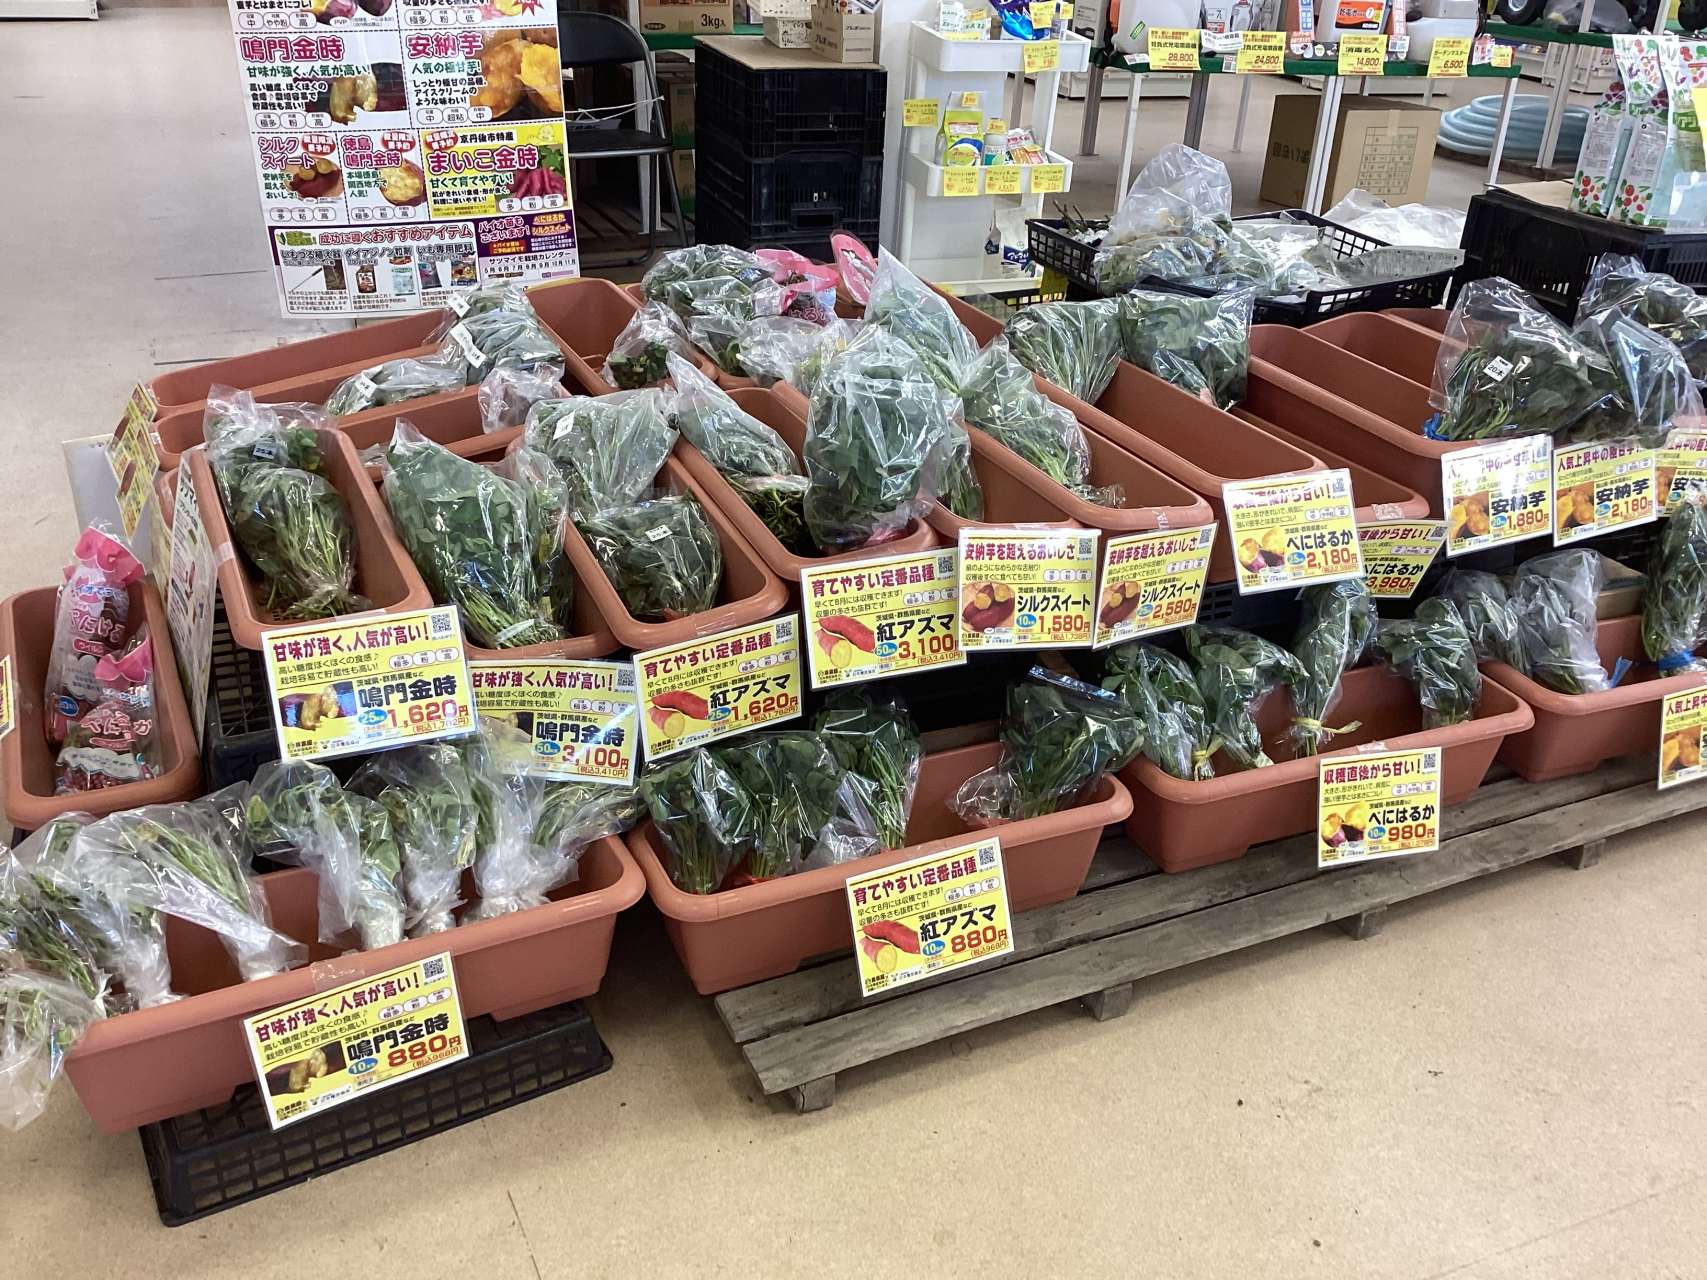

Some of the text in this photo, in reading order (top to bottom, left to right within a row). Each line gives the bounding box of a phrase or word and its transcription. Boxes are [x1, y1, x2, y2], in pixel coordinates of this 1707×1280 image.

[241, 36, 344, 62] 鳴門金時
[407, 31, 483, 59] 安納芋
[246, 64, 371, 79] 甘味が強く、人気が高い!
[411, 61, 482, 75] 人気の極甘芋!
[414, 86, 477, 97] アイスクリームの
[415, 96, 467, 107] ような味わい!
[258, 136, 299, 153] シルク
[341, 135, 373, 152] 徳島
[459, 131, 514, 144] 京丹後市特産
[262, 153, 316, 170] スイート
[343, 150, 403, 168] 鳴門金時
[427, 146, 539, 175] まいこ金時
[347, 179, 388, 189] 関西地方で
[430, 173, 513, 188] 甘くて育てやすい!
[265, 191, 298, 200] おいしさ!
[350, 190, 368, 198] 人気!
[319, 224, 474, 246] 成功に導くおすすめアイテム
[480, 224, 531, 244] ございます!
[416, 243, 475, 256] いも専用肥料
[489, 251, 572, 266] サツマイモ栽培カレンダー
[565, 258, 576, 266] 11月
[1596, 477, 1650, 506] 安納芋
[1491, 490, 1547, 516] 安納芋
[1611, 496, 1654, 518] 2,180円
[1506, 508, 1550, 530] 1,880円
[1286, 529, 1354, 551] べにはるか
[965, 543, 1076, 561] 安納芋を超えるおいしさ
[1108, 537, 1198, 567] 安納芋を超えるおいしさ
[1306, 547, 1358, 569] 2,180円
[811, 563, 935, 599] 育てやすい定番品種
[1140, 579, 1201, 605] シルクスイート
[1366, 576, 1416, 590] 3,980円
[1016, 593, 1091, 613] シルクスイート
[1152, 598, 1198, 621] 2,580円
[876, 613, 956, 643] 紅アズマ
[1038, 614, 1091, 635] 1,580円
[273, 621, 430, 663] 甘味が強く、人気が高い！
[643, 631, 774, 679] 育てやすい定番品種
[917, 652, 963, 665] (税込3,410円)
[280, 663, 379, 685] 栽培容易で貯蔵性も高い!
[356, 671, 424, 686] 茨城県・群馬県産など
[472, 670, 614, 692] 甘味が強く、人気が高い！
[357, 674, 457, 709] 鳴門金時
[709, 673, 791, 709] 紅アズマ
[387, 699, 470, 729] 1,620円
[731, 692, 799, 721] 1,620円
[535, 721, 625, 747] 鳴門金時
[562, 744, 630, 770] 3,100円
[576, 765, 629, 777] (税込3,410円)
[1323, 758, 1422, 785] 収穫直後から甘い！
[1368, 804, 1435, 826] べにはるか
[1388, 823, 1436, 842] 980円
[852, 856, 978, 907] 育てやすい定番品種
[857, 887, 945, 917] 早くて8月には収穫できます!
[858, 900, 930, 927] 収量の多さも抜群です!
[919, 904, 997, 943] 紅アズマ
[950, 925, 1008, 954] 880円
[970, 940, 1010, 958] (税込968円)
[255, 971, 421, 1044] 甘味が強く、人気が高い！
[346, 1012, 450, 1062] 鳴門金時
[387, 1034, 463, 1068] 880円
